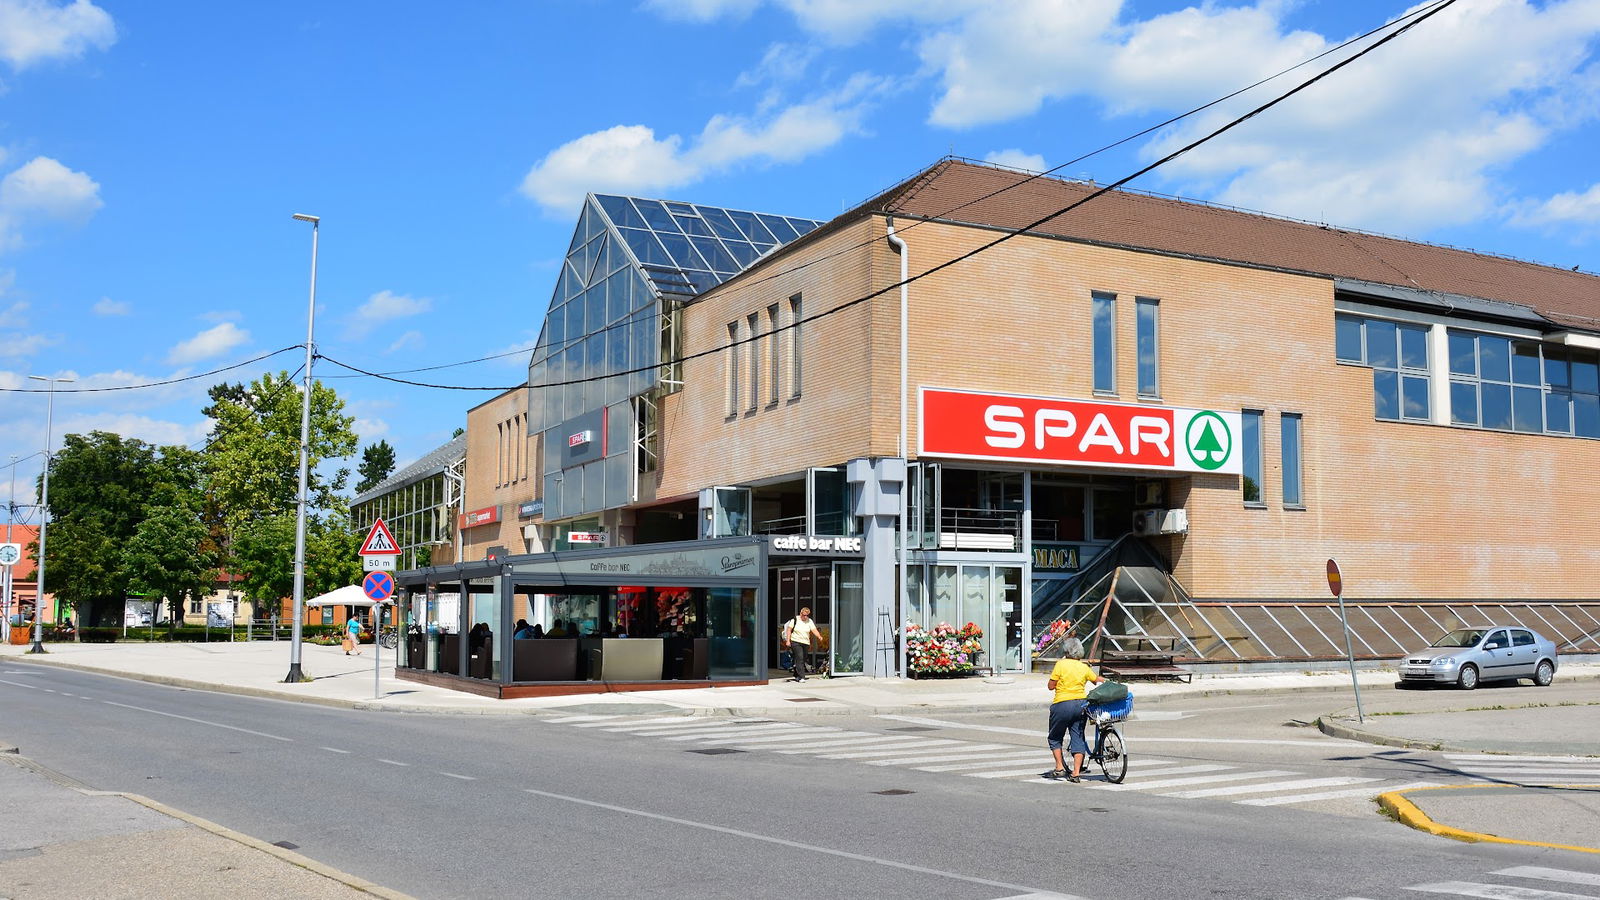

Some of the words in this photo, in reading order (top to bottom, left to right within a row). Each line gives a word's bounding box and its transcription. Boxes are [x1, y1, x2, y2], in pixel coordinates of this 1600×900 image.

[984, 404, 1171, 458] SPAR
[774, 536, 807, 549] caffe
[809, 537, 833, 550] bar
[835, 538, 861, 551] NEC
[619, 563, 631, 571] NEC
